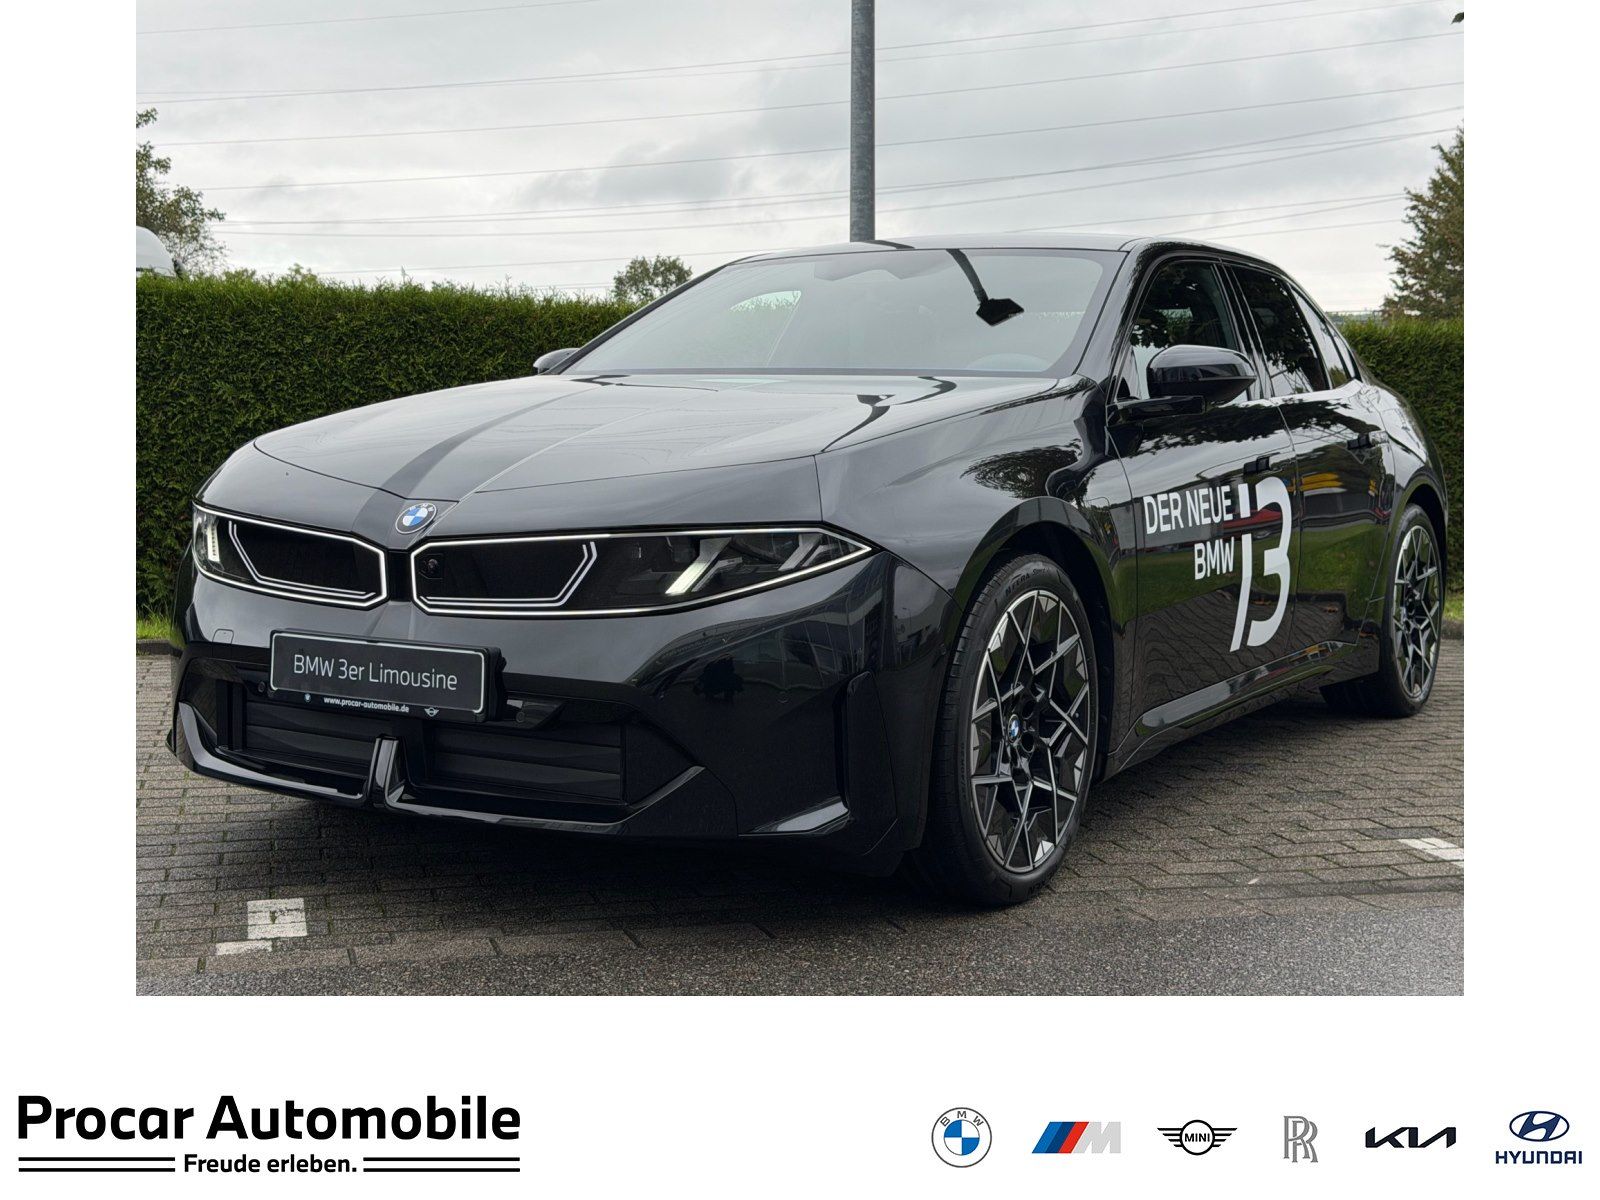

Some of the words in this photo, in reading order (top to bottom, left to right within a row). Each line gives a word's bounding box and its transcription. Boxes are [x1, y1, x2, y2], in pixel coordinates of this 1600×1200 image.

[1143, 495, 1184, 535] DER
[1185, 485, 1233, 527] NEUE
[1194, 536, 1235, 580] BMW
[293, 654, 334, 677] BMW
[338, 659, 365, 681] 3er
[369, 662, 458, 691] Limousine
[323, 697, 410, 713] www.procar-automobile.de
